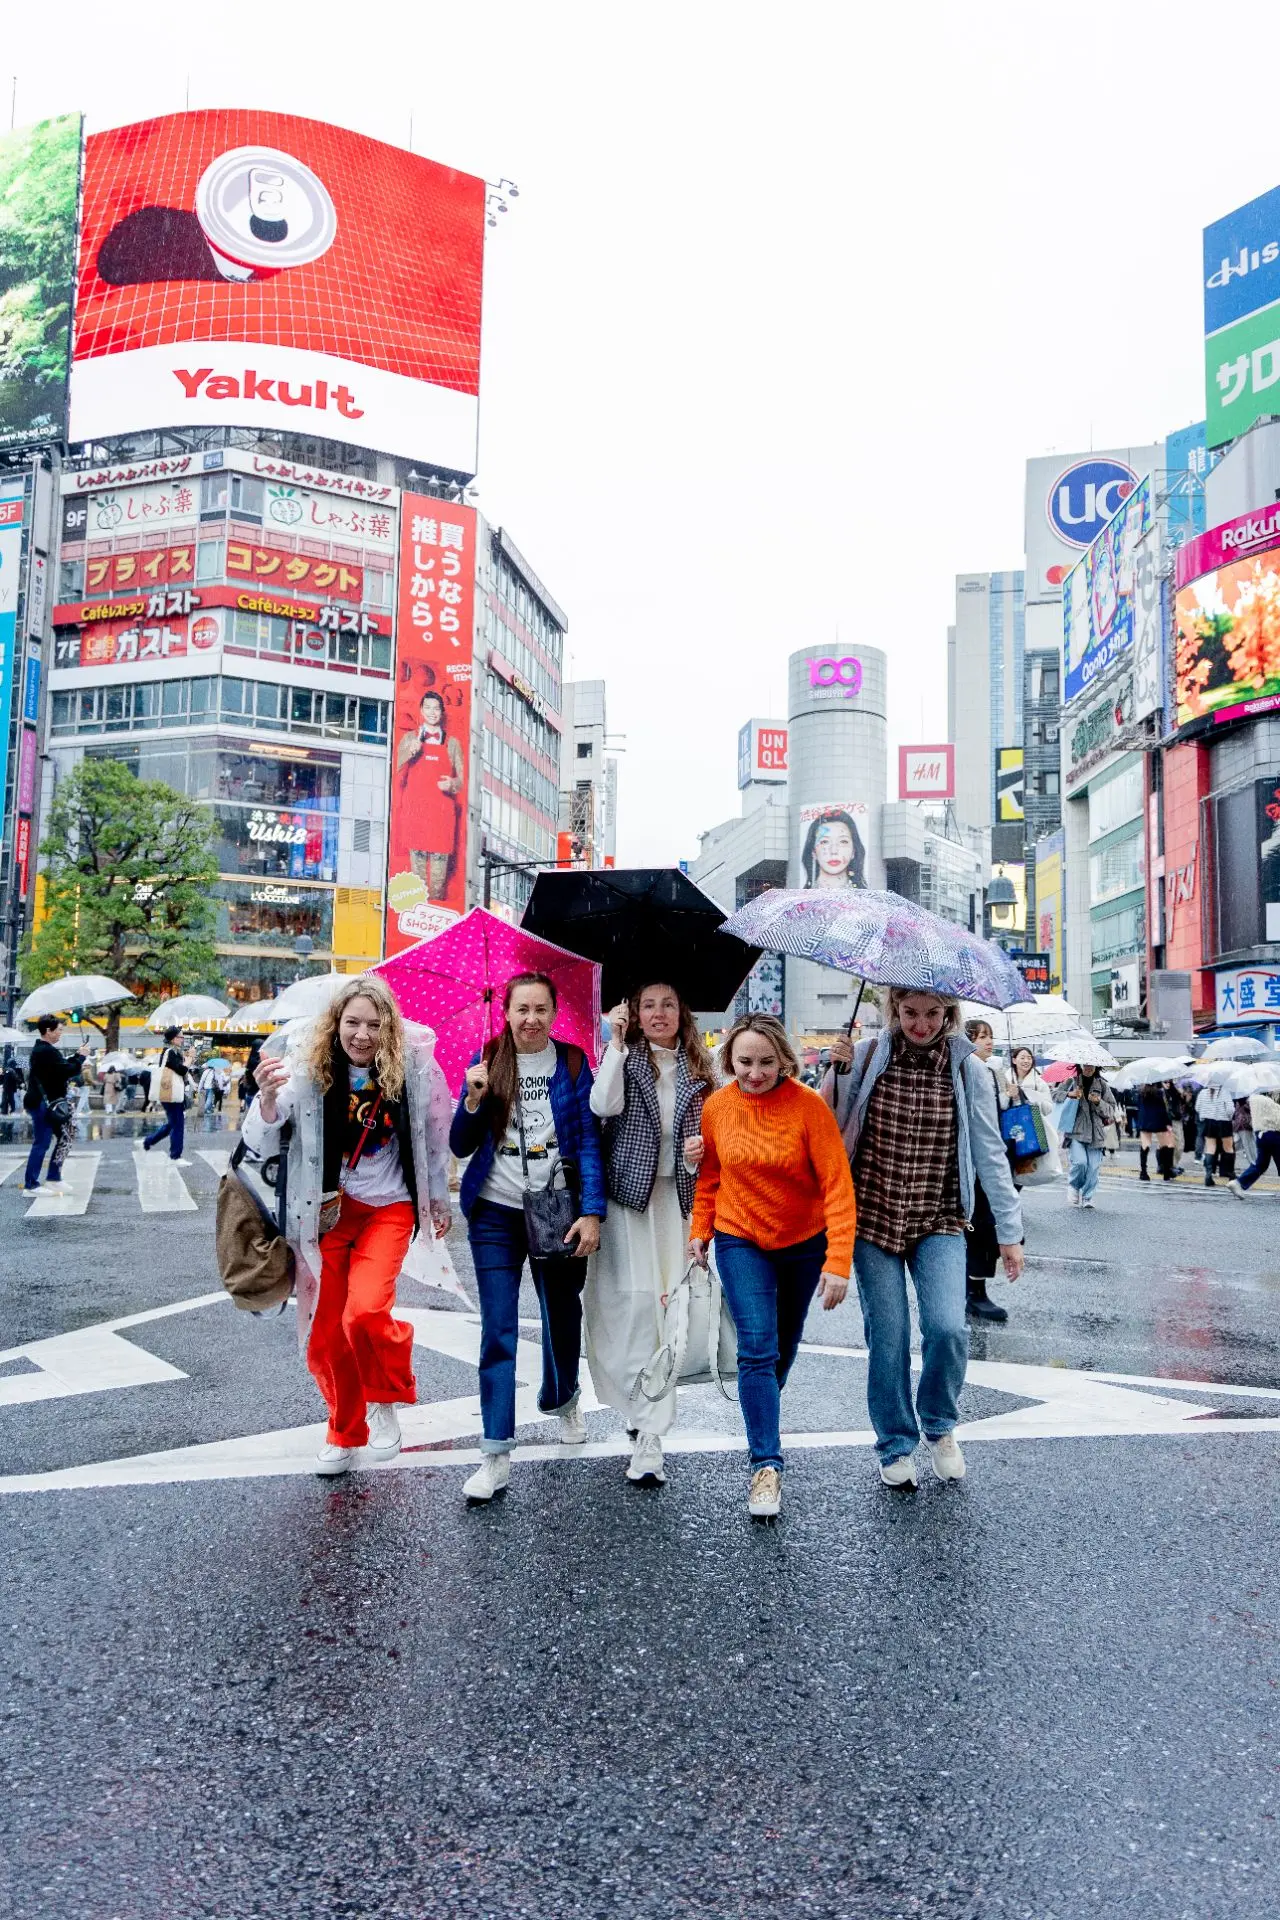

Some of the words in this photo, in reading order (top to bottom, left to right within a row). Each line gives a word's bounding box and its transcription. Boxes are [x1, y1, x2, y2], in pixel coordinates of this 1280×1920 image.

[172, 367, 365, 420] Yakult
[254, 456, 392, 500] しゃぶしゃぶバイキング
[66, 509, 87, 527] 9F
[127, 488, 192, 520] しゃぶ葉
[310, 500, 391, 538] しゃぶ葉
[1058, 480, 1121, 524] UC
[1221, 510, 1280, 551] Rakut
[88, 549, 193, 586] プライス
[228, 546, 359, 592] コンタクト
[410, 514, 437, 643] 推しから。
[438, 521, 464, 647] 買うなら、
[147, 590, 200, 617] ガスト
[319, 606, 378, 634] ガスト
[57, 640, 81, 660] 7F
[116, 626, 182, 663] ガスト
[804, 657, 862, 698] 109
[762, 733, 784, 748] UN
[246, 821, 307, 844] Ushi8
